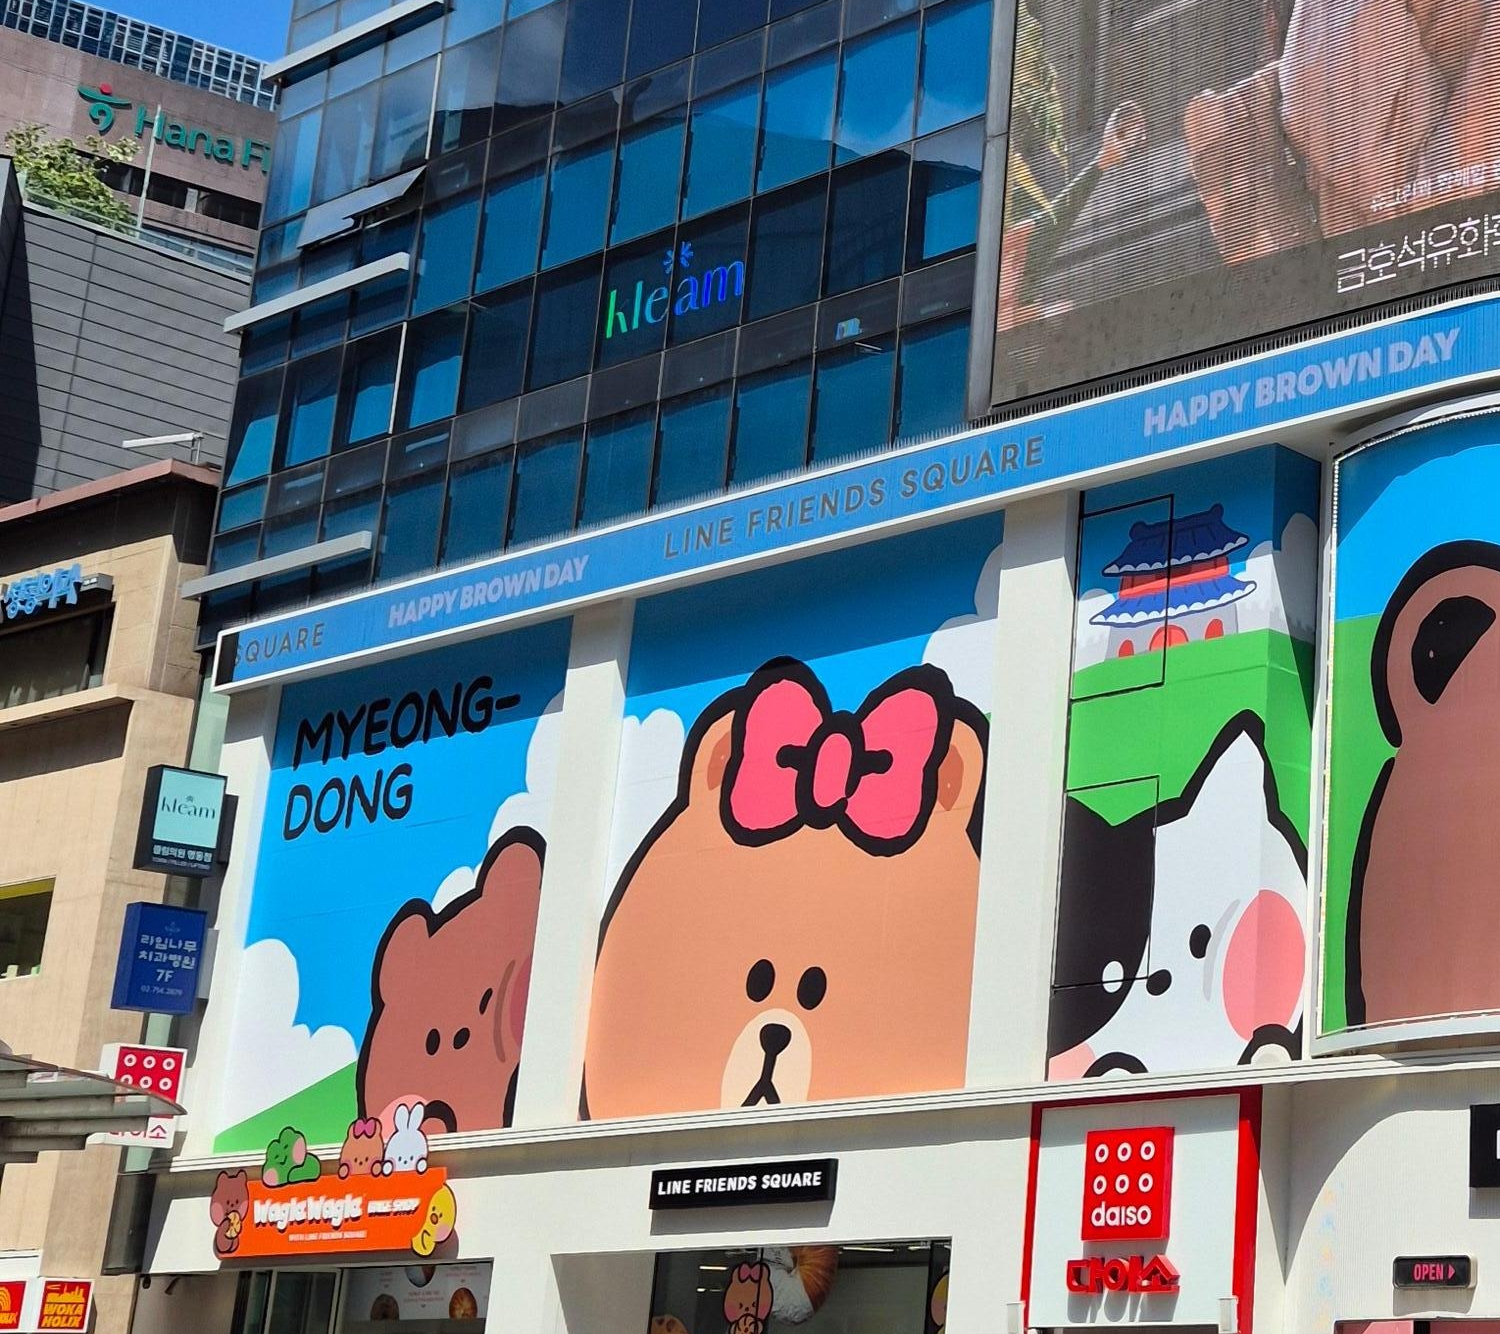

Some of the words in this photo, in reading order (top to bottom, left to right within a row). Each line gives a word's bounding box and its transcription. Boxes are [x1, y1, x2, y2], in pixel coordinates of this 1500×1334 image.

[134, 102, 234, 166] Hana
[606, 260, 745, 339] kleam
[1142, 380, 1252, 439] HAPPY
[1255, 343, 1382, 409] BROWN
[1386, 325, 1463, 377] DAY
[663, 517, 736, 562] LINE
[745, 478, 886, 539] FRIENDS
[900, 435, 1046, 501] SQUARE
[388, 587, 460, 628] HAPPY
[459, 568, 542, 611] BROWN
[541, 555, 590, 589] DAY
[291, 675, 522, 771] MYEONG-
[161, 796, 216, 820] kleam
[282, 762, 414, 840] DONG
[138, 950, 196, 970] 치과병원
[140, 934, 197, 953] 라임나무
[156, 968, 175, 983] 7F
[657, 1179, 692, 1196] LINE
[694, 1175, 758, 1194] FRIENDS
[761, 1171, 823, 1189] SQUARE
[1091, 1201, 1152, 1227] daiso
[1066, 1254, 1181, 1294] 다이소
[1413, 1263, 1444, 1282] OPEN
[43, 1303, 85, 1316] WOKA
